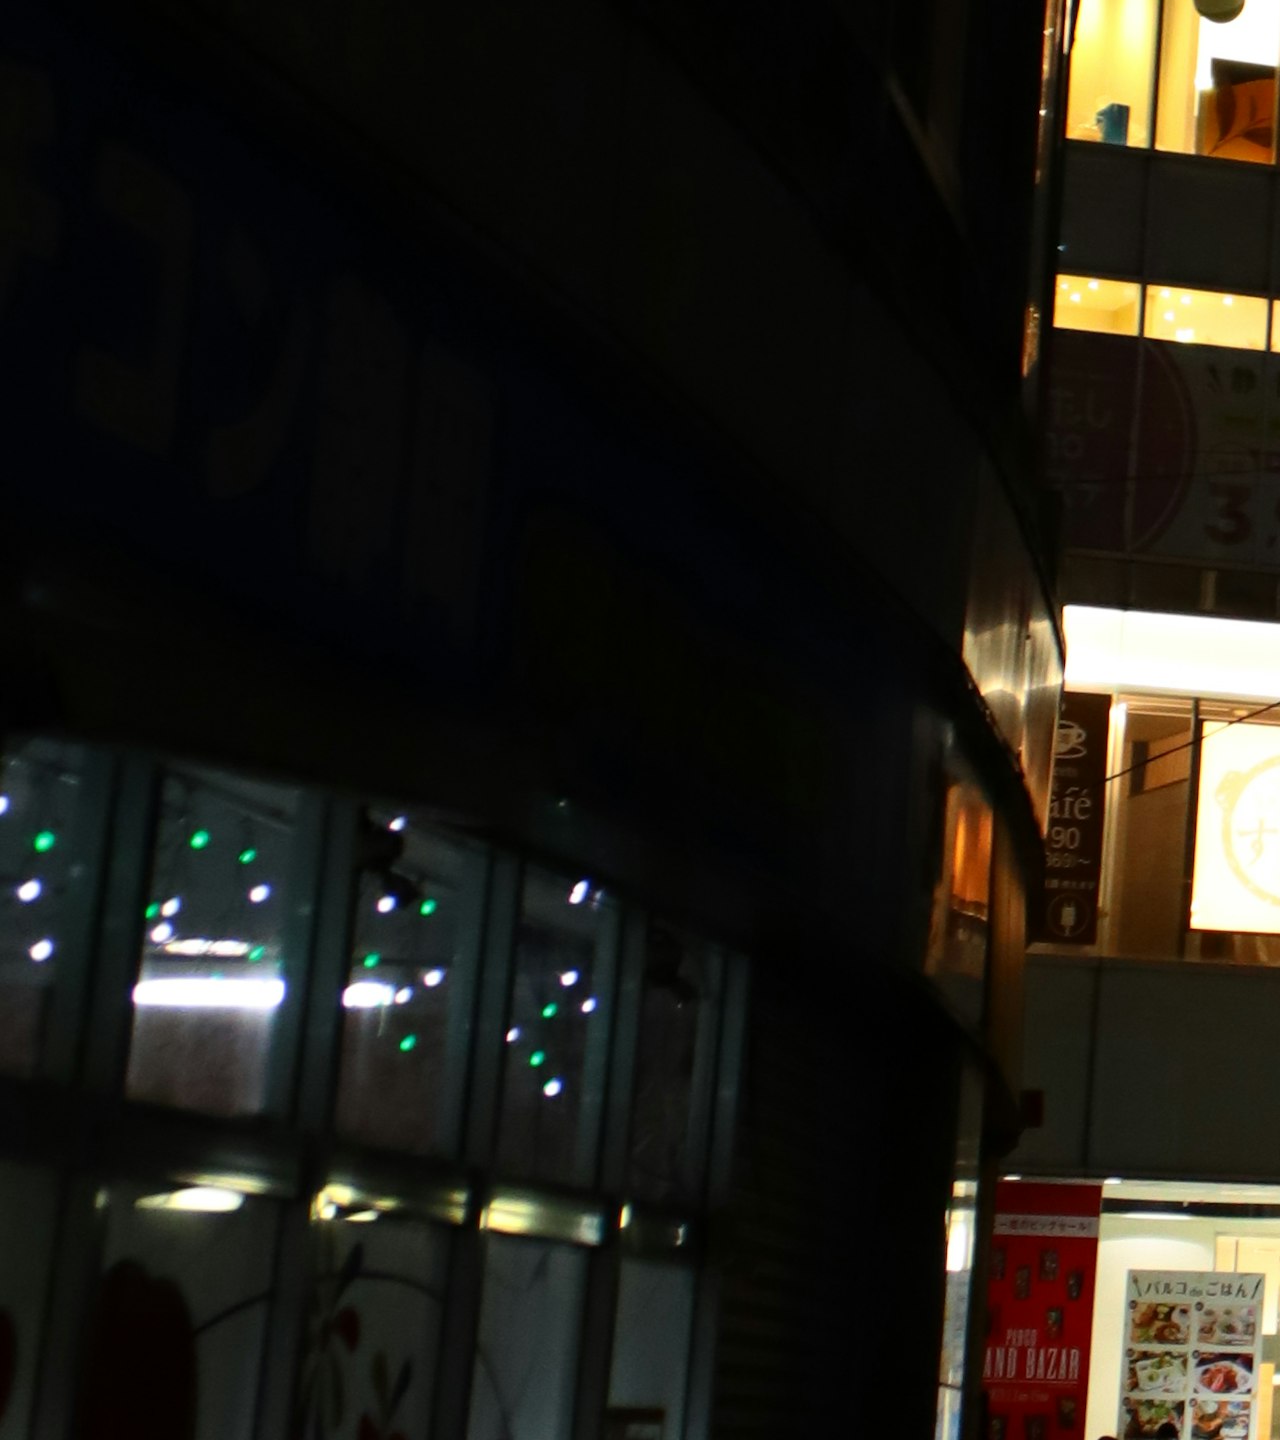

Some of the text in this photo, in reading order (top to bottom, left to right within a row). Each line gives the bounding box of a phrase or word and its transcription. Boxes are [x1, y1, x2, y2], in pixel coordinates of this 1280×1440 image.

[1050, 787, 1092, 821] afé
[983, 1346, 1080, 1380] AND BAZAR
